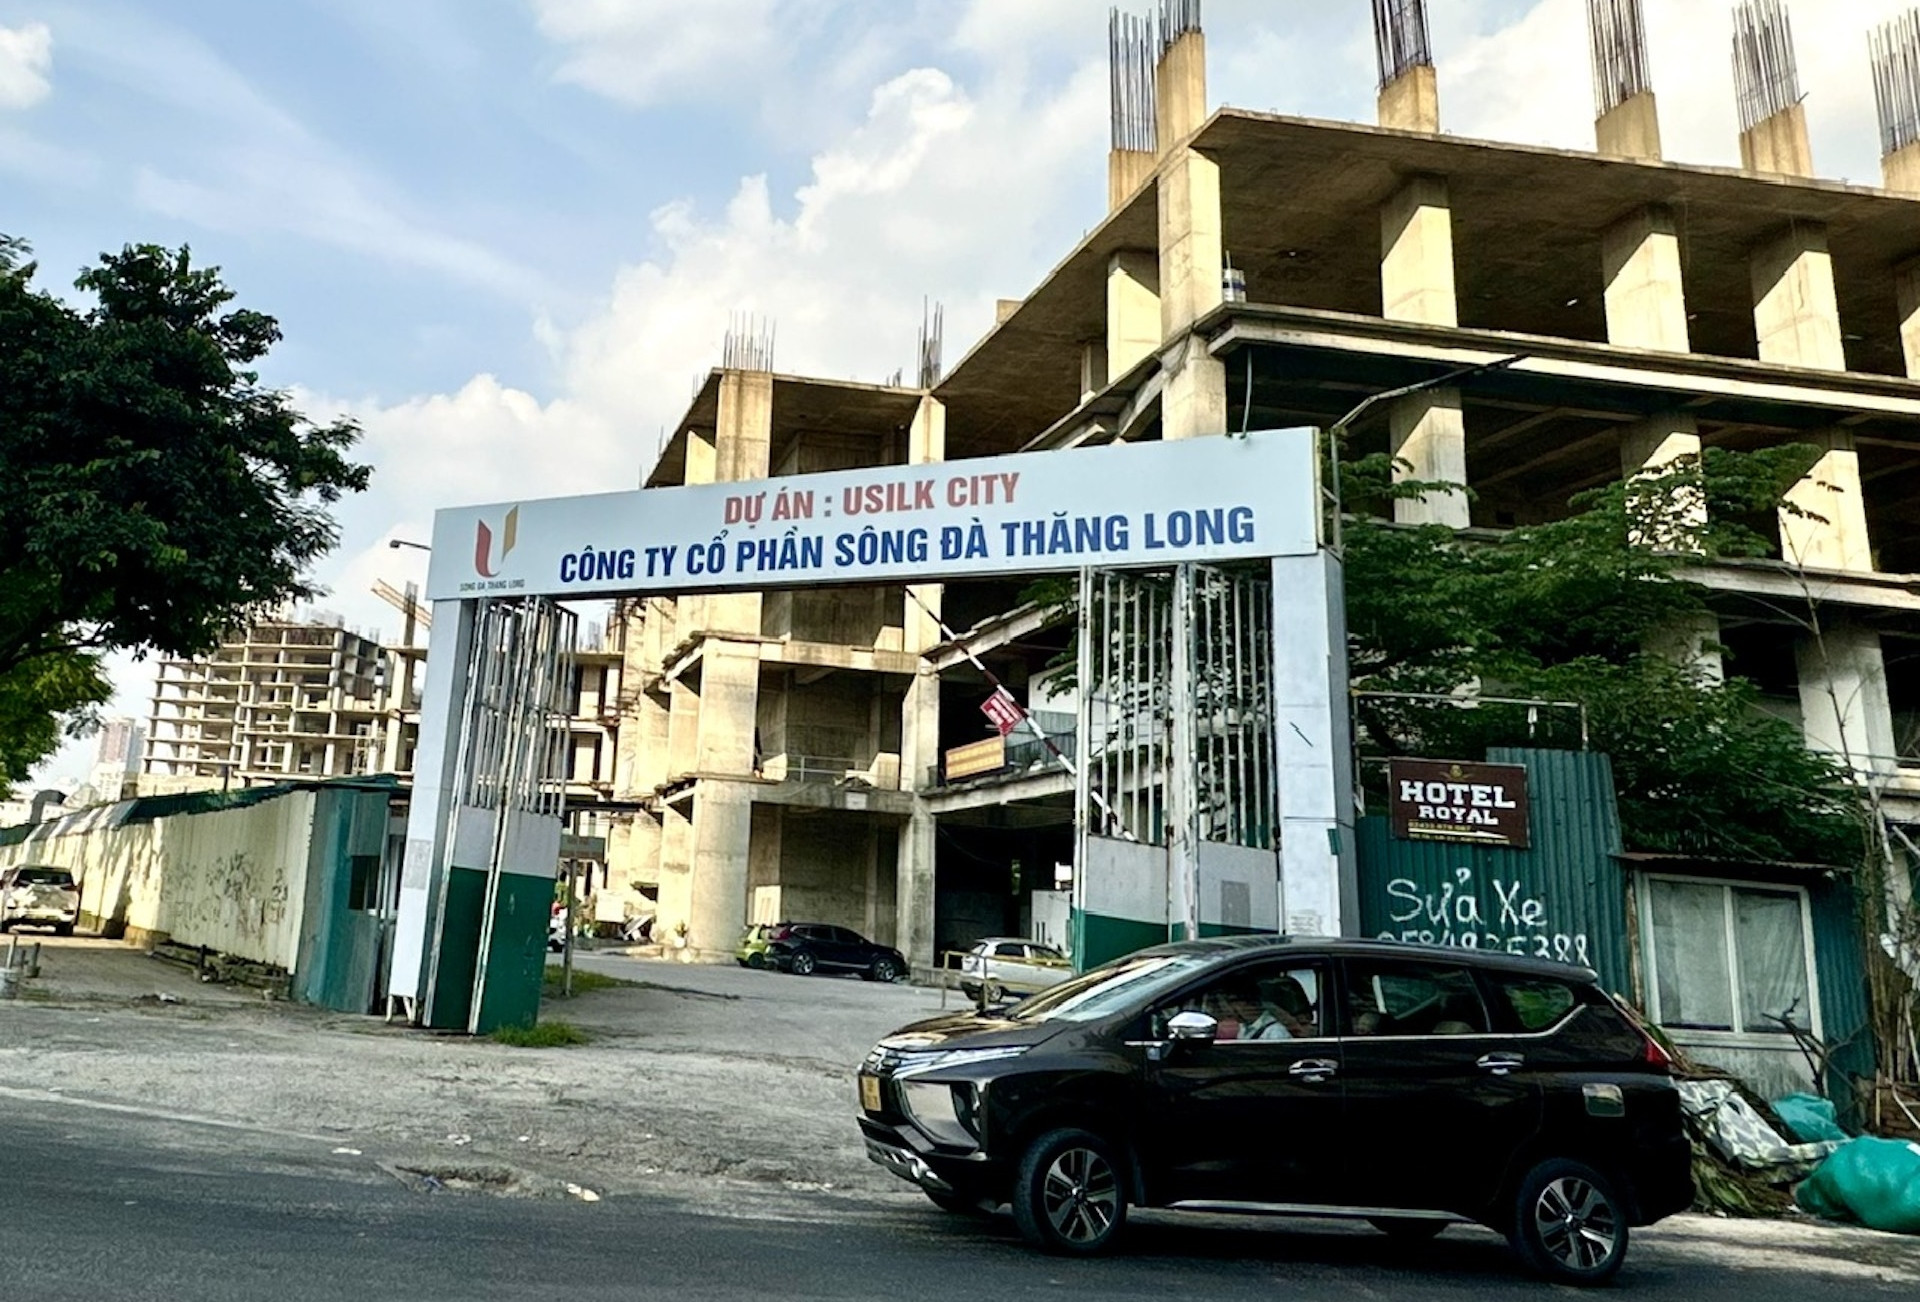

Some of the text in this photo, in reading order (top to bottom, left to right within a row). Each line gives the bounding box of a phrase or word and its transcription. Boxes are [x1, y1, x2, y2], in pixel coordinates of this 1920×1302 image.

[724, 491, 766, 530] DỰ
[771, 486, 814, 521] ÁN
[842, 479, 935, 516] USILK
[946, 471, 1021, 508] CITY
[560, 506, 1255, 583] CÔNG TY CỔ PHẦN SÔNG ĐÀ THĂNG LONG
[1400, 780, 1516, 809] HOTEL
[1418, 805, 1499, 825] ROYAL
[1492, 879, 1548, 930] Xe
